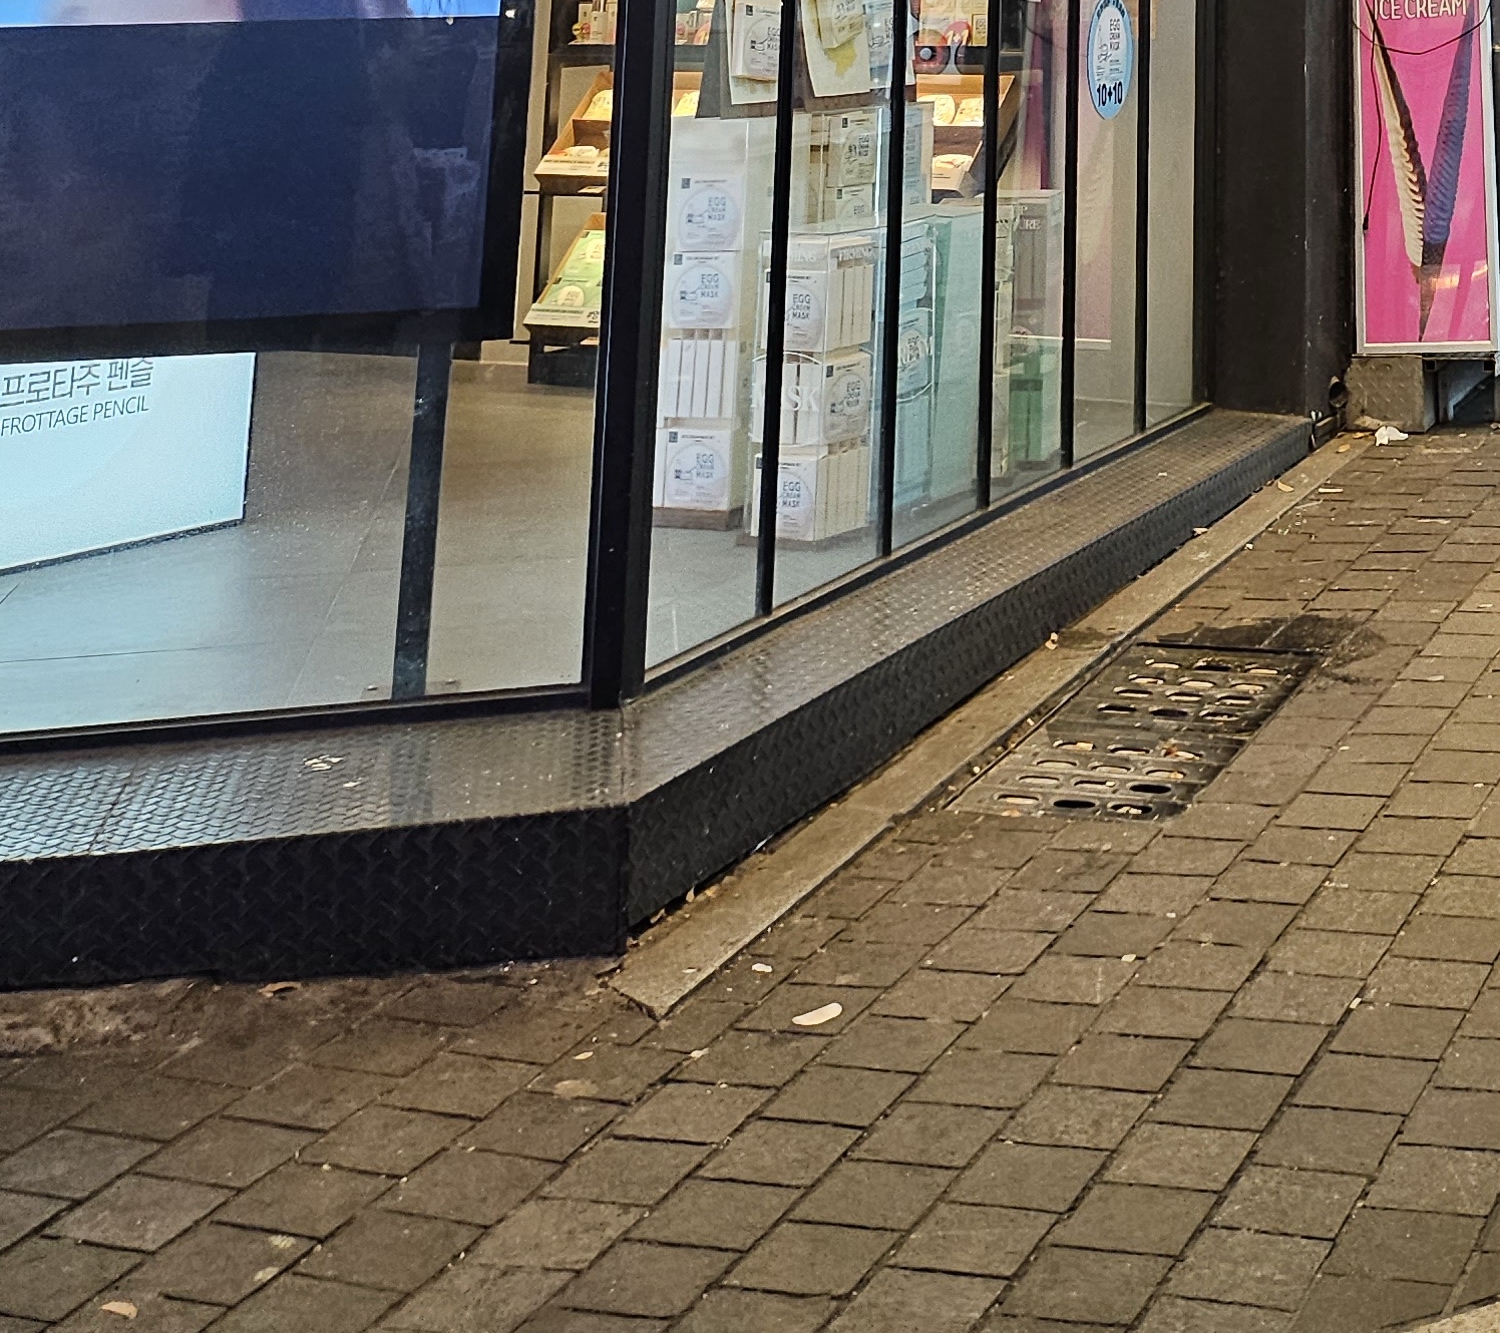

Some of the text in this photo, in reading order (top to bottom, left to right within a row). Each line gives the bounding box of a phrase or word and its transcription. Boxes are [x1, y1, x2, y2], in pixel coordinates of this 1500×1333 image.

[1096, 82, 1123, 107] 10+10
[0, 357, 154, 408] 프로타주 펜슬
[1, 395, 149, 435] FROTTAGE PENCIL
